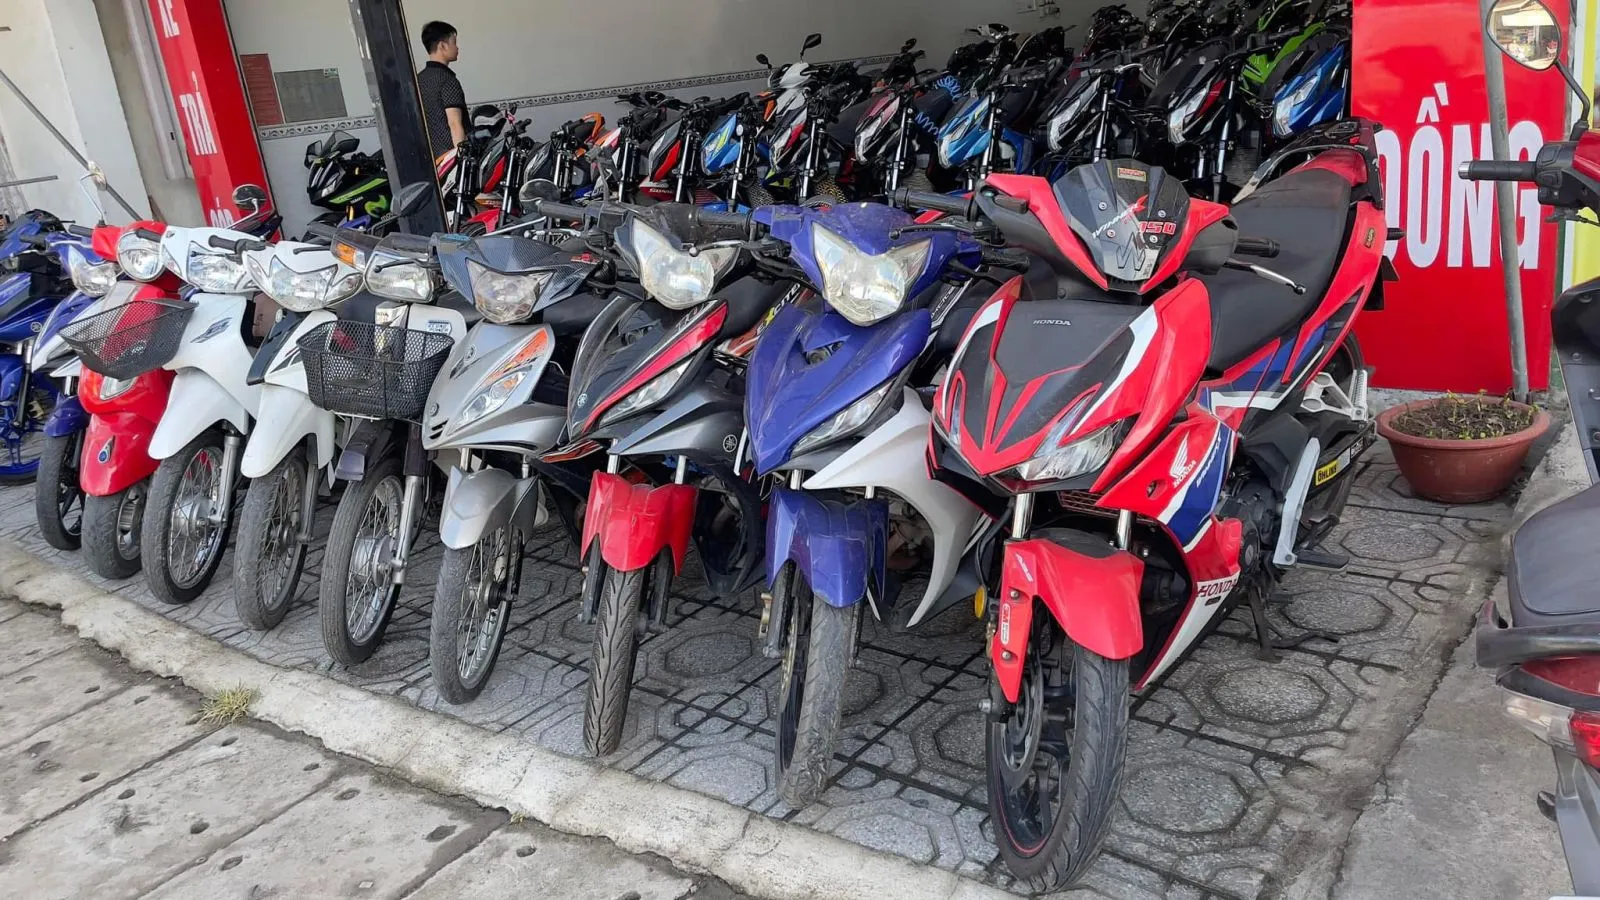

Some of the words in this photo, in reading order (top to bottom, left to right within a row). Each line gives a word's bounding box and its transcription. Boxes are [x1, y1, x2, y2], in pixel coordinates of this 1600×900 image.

[179, 71, 217, 156] TRẢ
[1138, 221, 1177, 235] 150
[1172, 459, 1197, 489] HONDA
[1198, 578, 1238, 597] HONDA
